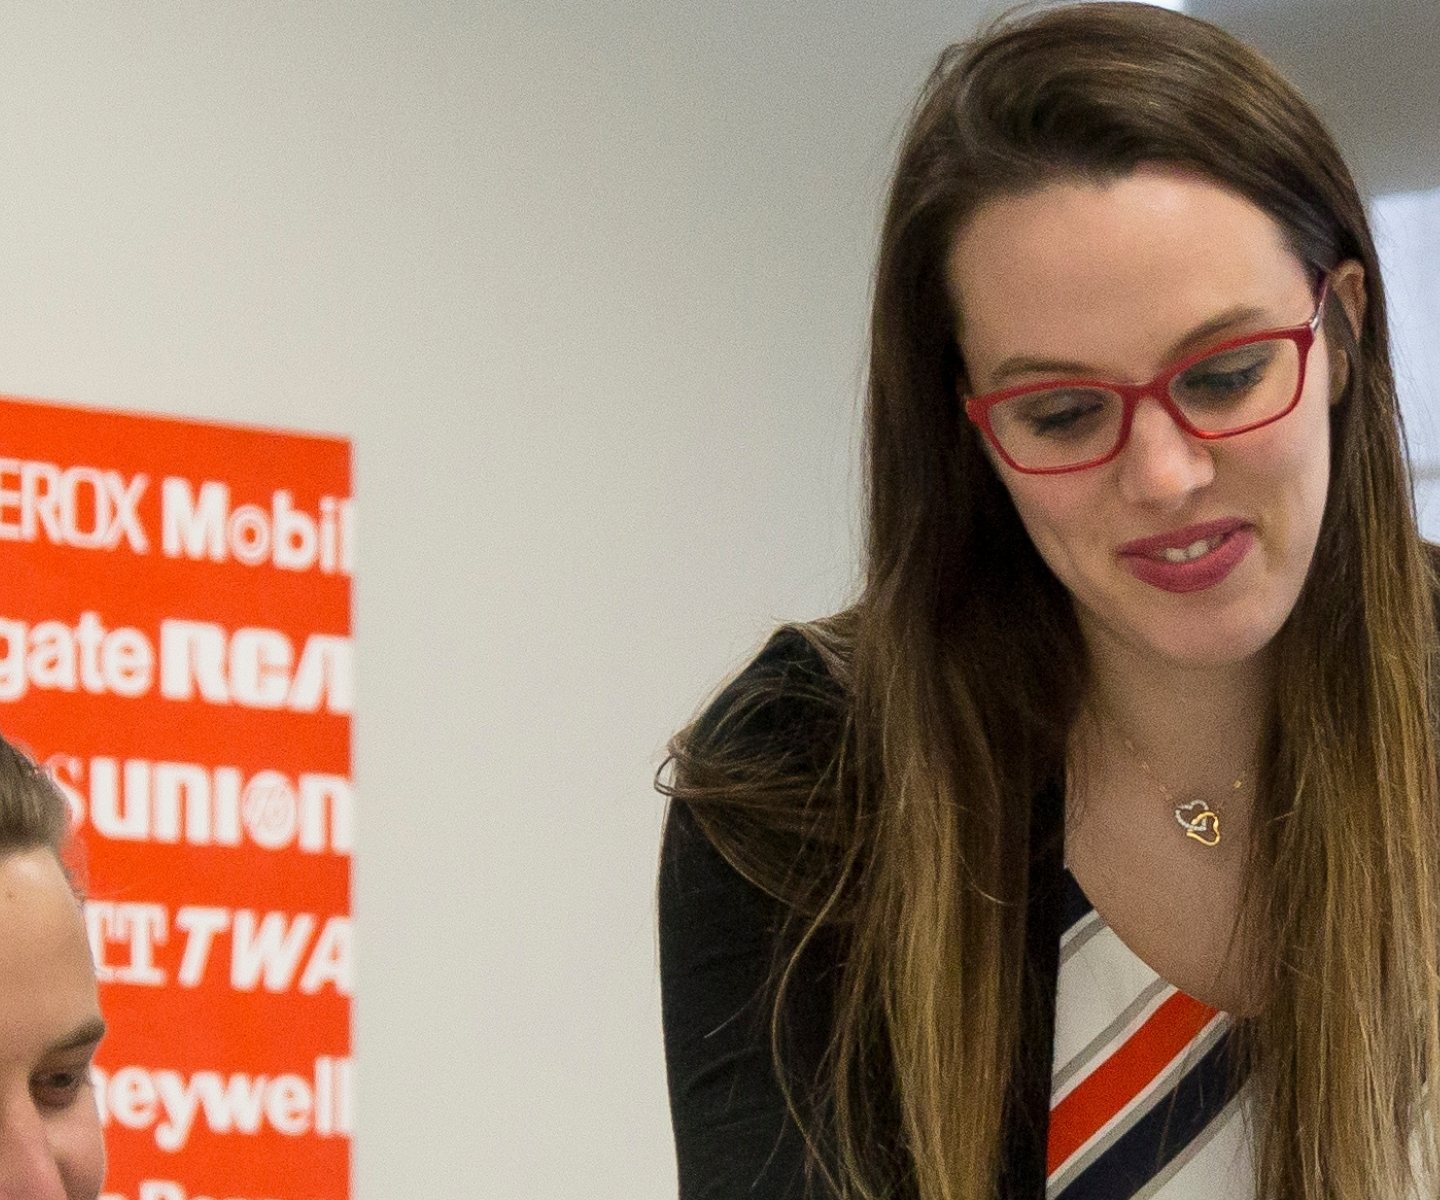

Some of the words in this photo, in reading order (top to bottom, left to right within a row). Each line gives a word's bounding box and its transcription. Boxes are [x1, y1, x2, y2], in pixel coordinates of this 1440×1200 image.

[162, 476, 353, 576] Mobil
[161, 618, 354, 714] RCA
[85, 902, 169, 986] TT
[176, 905, 354, 999] TWA
[89, 1056, 354, 1152] eywell
